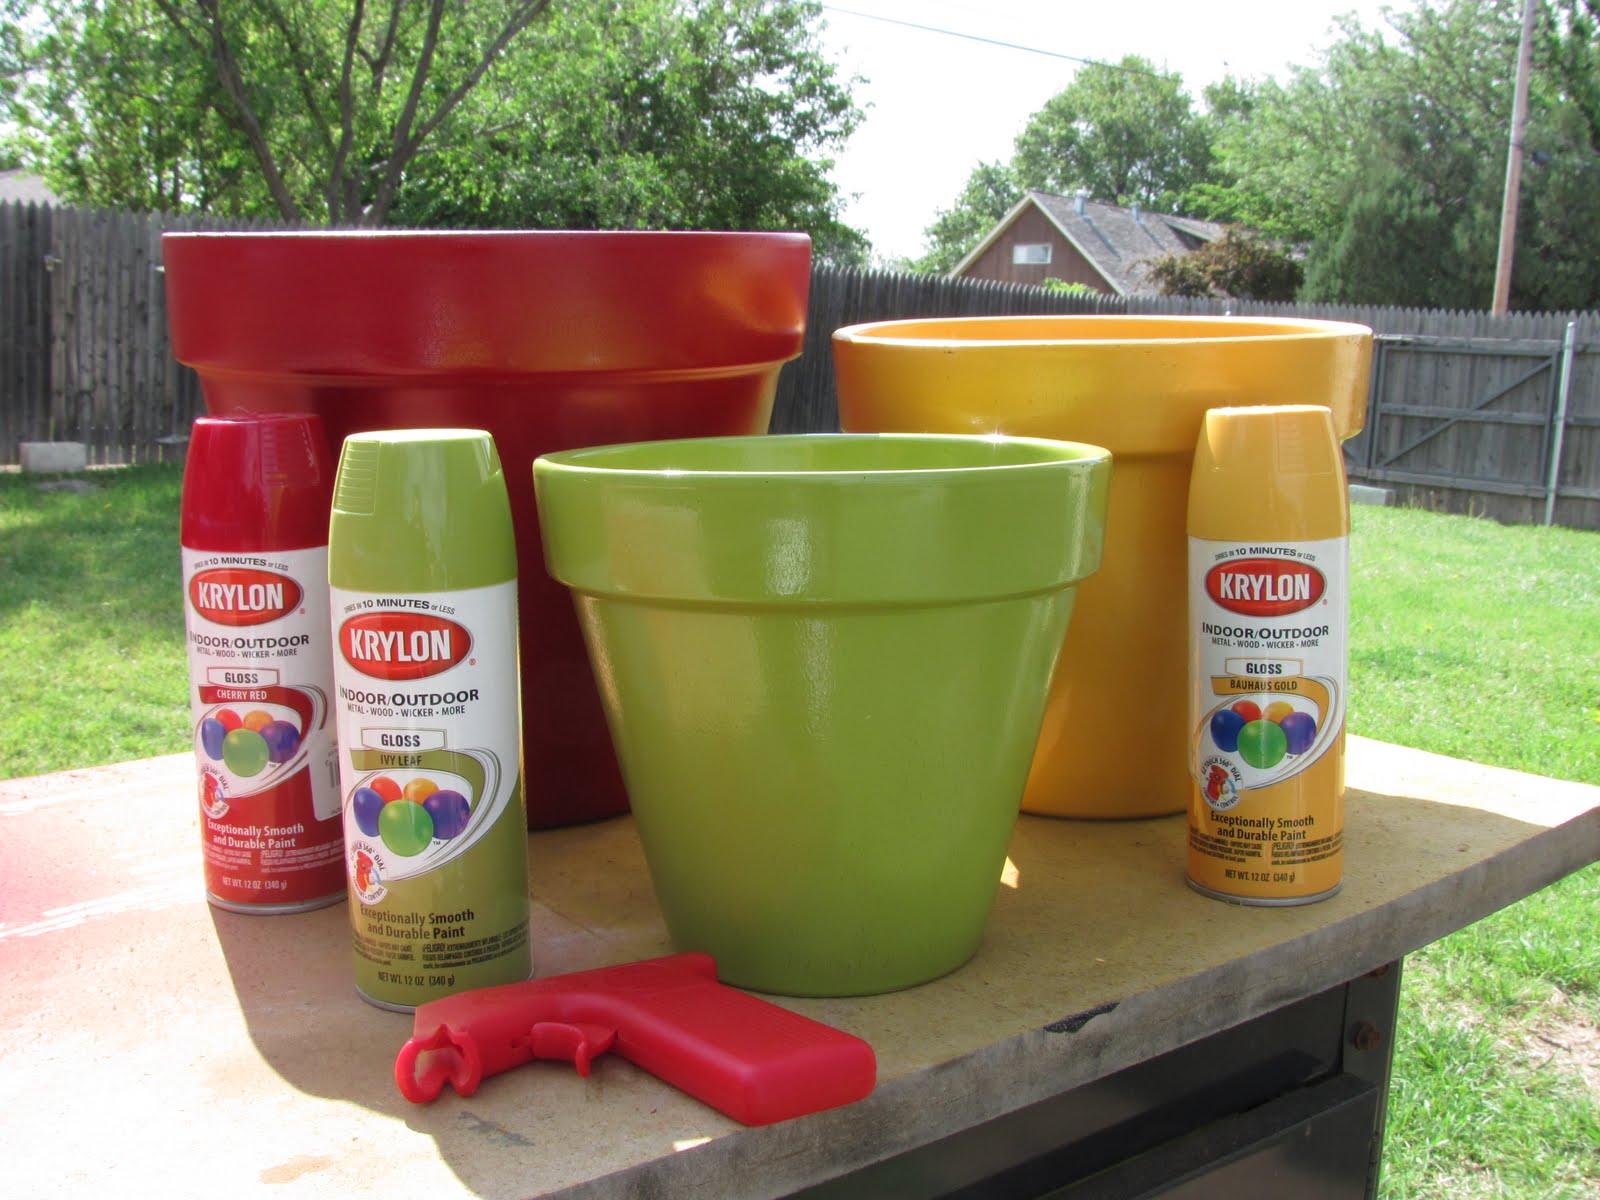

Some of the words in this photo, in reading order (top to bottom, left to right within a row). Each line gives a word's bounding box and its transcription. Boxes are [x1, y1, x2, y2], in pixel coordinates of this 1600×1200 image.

[1250, 548, 1296, 556] MINUTES
[1303, 553, 1315, 561] LESS
[221, 557, 266, 566] MINUTES
[275, 563, 288, 571] LESS
[1220, 573, 1310, 601] KRYLON
[198, 582, 284, 611] KRYLON
[363, 600, 373, 608] 10
[377, 599, 429, 609] MINUTES
[439, 605, 455, 615] LESS
[1202, 622, 1328, 639] INDOOR/OUTDOOR
[190, 631, 309, 648] INDOOR/OUTDOOR
[351, 628, 450, 662] KRYLON
[1212, 637, 1231, 646] METAL
[1301, 639, 1319, 647] MORE
[197, 648, 211, 656] METAL
[1246, 663, 1282, 674] GLOSS
[225, 673, 258, 683] GLOSS
[1230, 680, 1272, 690] BAUHAUS
[1275, 681, 1297, 690] GOLD
[217, 690, 247, 699] CHERRY
[250, 691, 267, 699] RED
[340, 686, 479, 706] INDOOR/OUTDOOR
[348, 705, 364, 715] METAL
[370, 708, 393, 716] WOOD
[401, 709, 433, 717] WICKER
[442, 706, 465, 715] MORE
[381, 734, 420, 747] GLOSS
[380, 755, 395, 765] IVY
[398, 756, 422, 766] LEAF
[219, 775, 228, 789] DIAL
[1231, 768, 1241, 782] DIAL
[1211, 811, 1275, 830] Exceptionally
[1277, 816, 1314, 827] Smooth
[208, 818, 262, 838] Exceptionally
[264, 823, 304, 836] Smooth
[1217, 827, 1234, 838] and
[1237, 829, 1277, 841] Durable
[1281, 830, 1306, 841] Paint
[213, 835, 226, 845] and
[228, 839, 265, 849] Durable
[268, 838, 295, 848] Paint
[374, 854, 385, 871] DIAL
[1225, 869, 1236, 878] NET
[1238, 871, 1249, 880] WT.
[1251, 872, 1259, 880] 12
[1260, 873, 1269, 881] OZ
[1273, 873, 1288, 882] (340
[1289, 872, 1295, 882] g)
[223, 877, 231, 886] NET
[244, 880, 251, 888] 12
[253, 880, 260, 889] OZ
[361, 904, 425, 927] Exceptionally
[429, 909, 474, 924] Smooth
[368, 923, 383, 936] and
[386, 925, 430, 939] Durable
[434, 927, 465, 939] Paint
[378, 972, 389, 981] NET
[390, 974, 403, 984] WT.
[404, 976, 413, 985] 12
[415, 976, 424, 985] OZ
[429, 975, 446, 985] (340
[447, 975, 455, 986] g)
